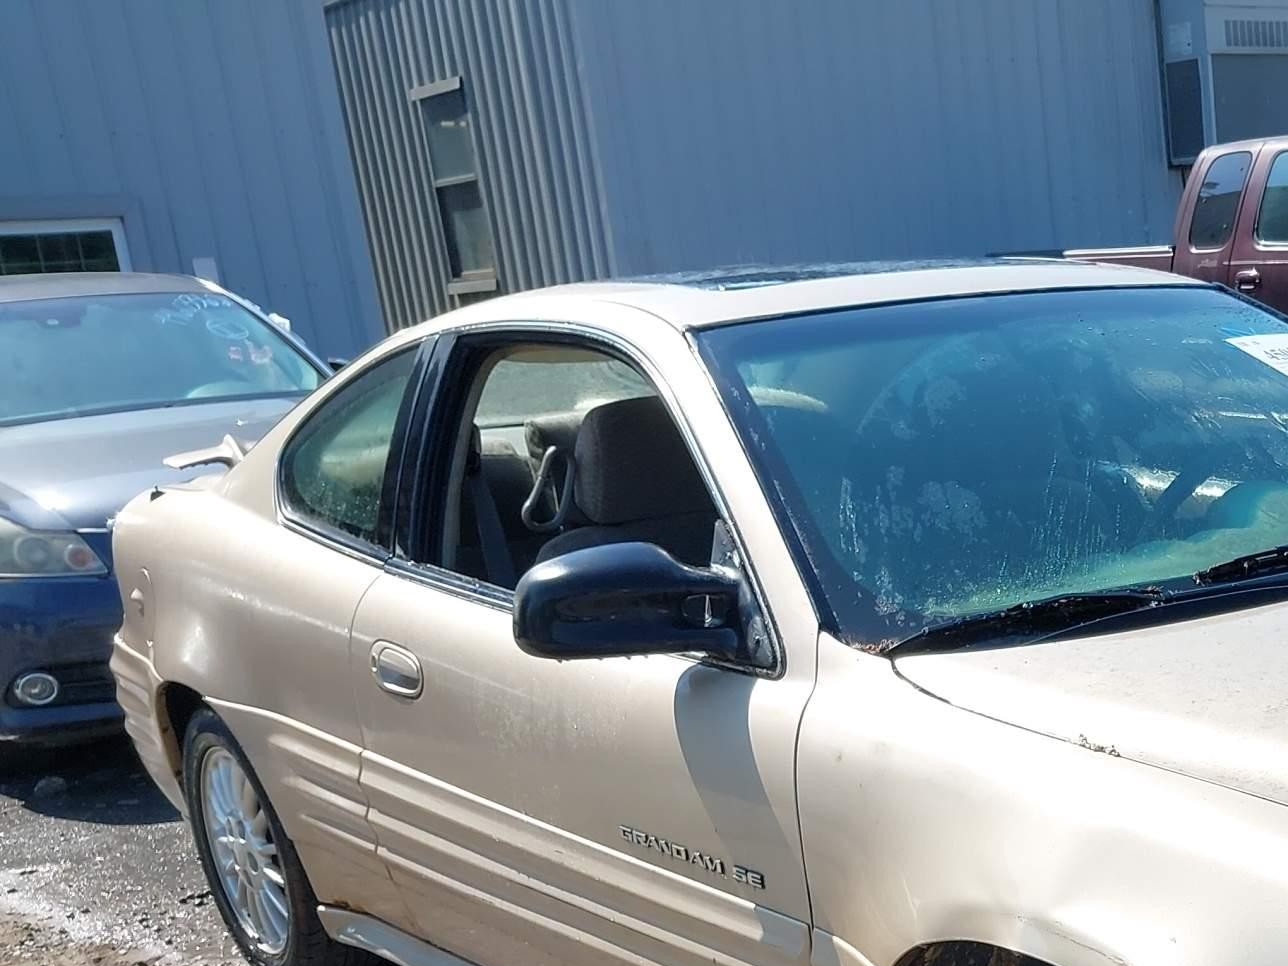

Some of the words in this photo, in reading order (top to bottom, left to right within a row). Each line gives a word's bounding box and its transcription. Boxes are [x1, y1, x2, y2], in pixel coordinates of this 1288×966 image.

[618, 824, 689, 861] GRAND
[690, 851, 725, 875] AM
[732, 864, 766, 889] SE
